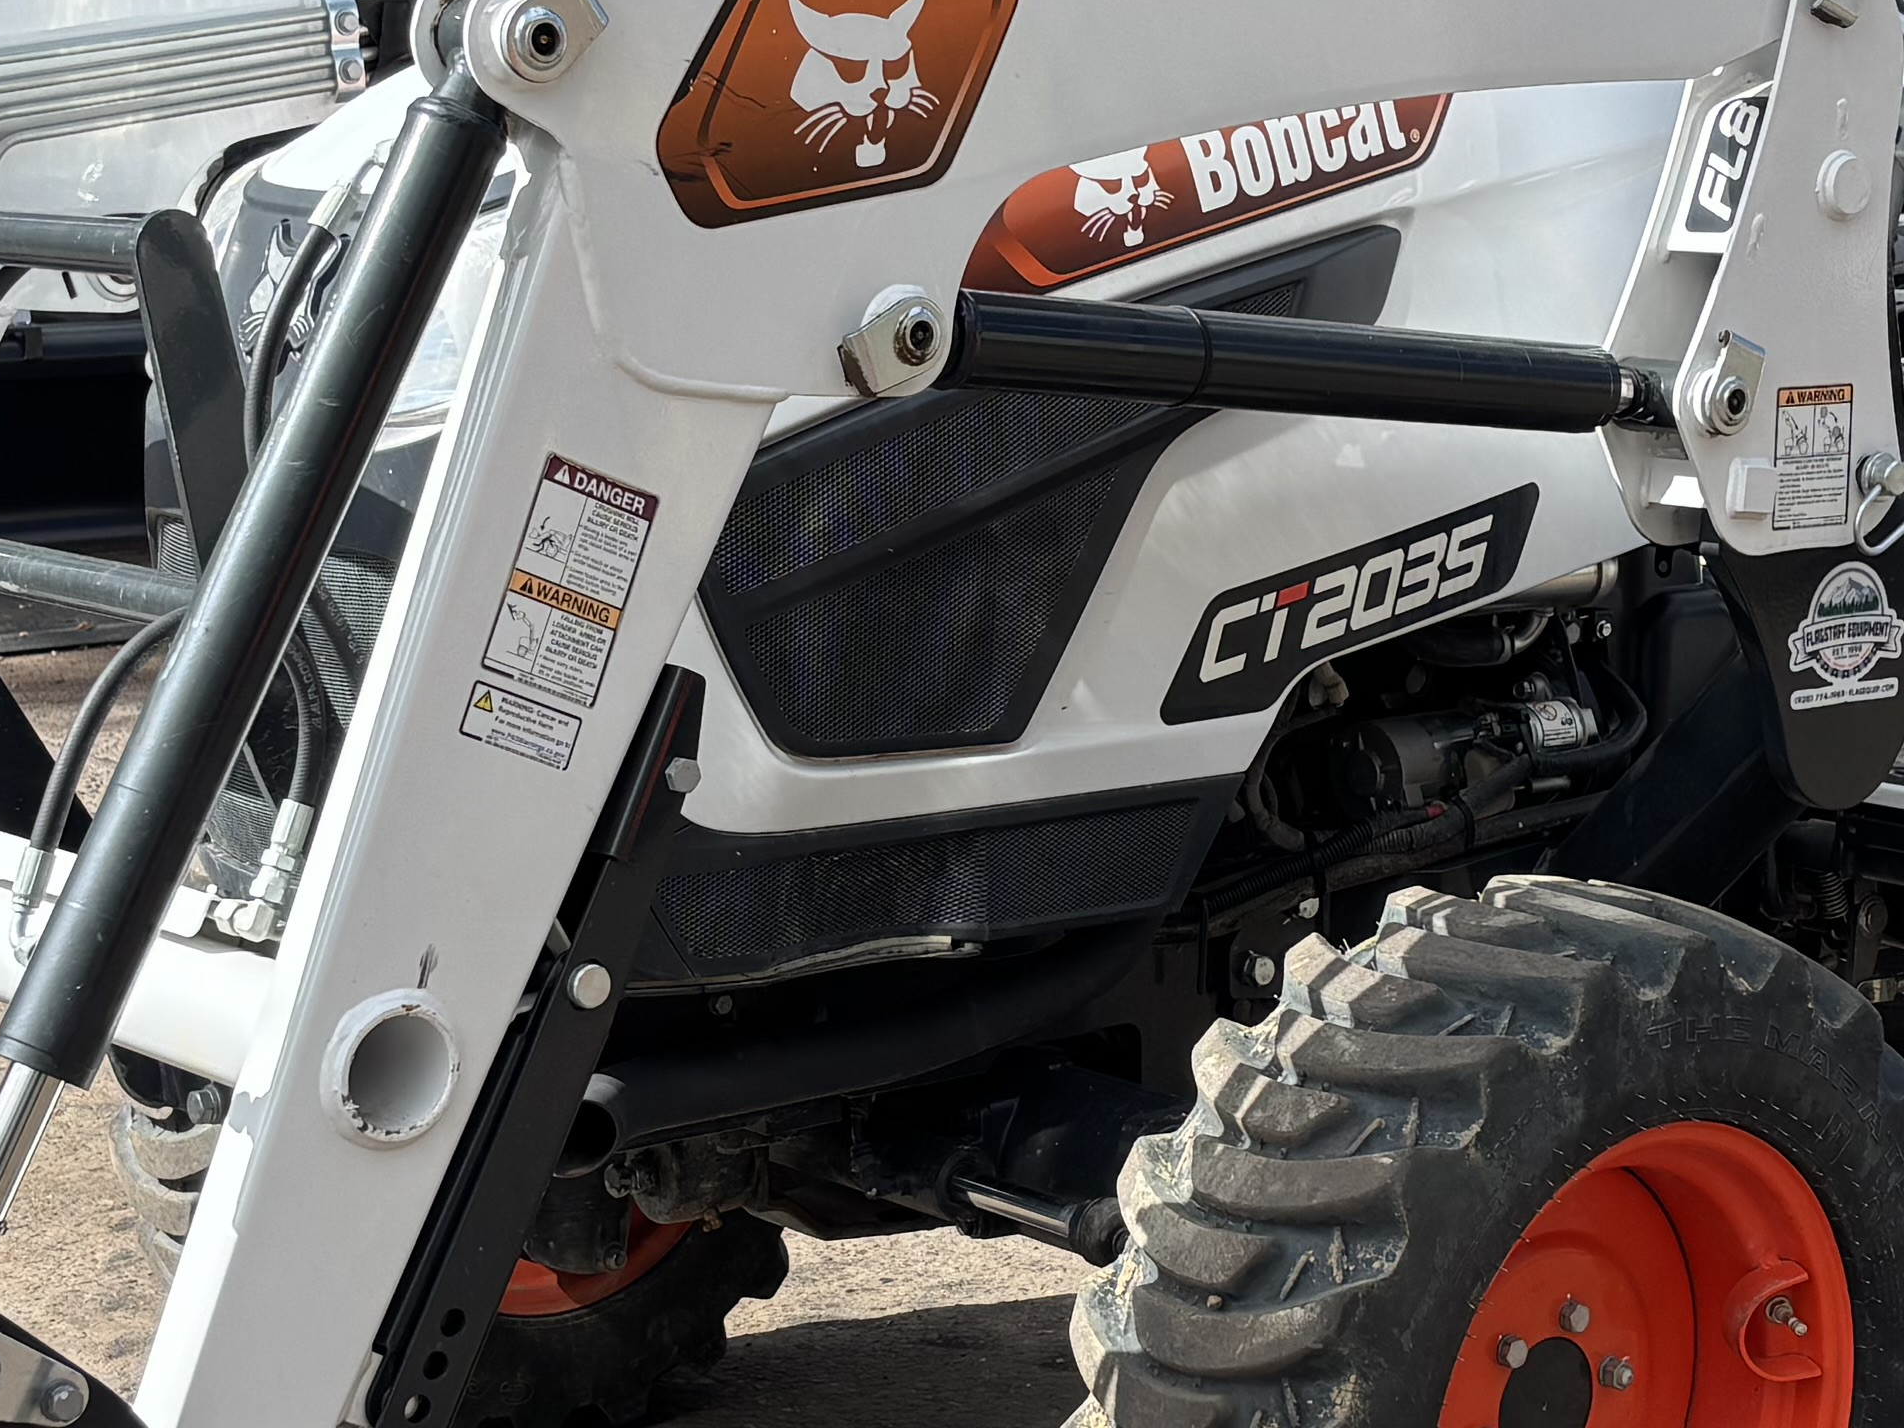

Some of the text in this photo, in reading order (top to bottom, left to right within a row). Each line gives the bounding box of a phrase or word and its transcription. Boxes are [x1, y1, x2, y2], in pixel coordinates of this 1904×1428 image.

[1179, 100, 1407, 213] Bobcat
[1797, 388, 1845, 404] WARNING
[573, 472, 646, 516] DANGER
[537, 581, 610, 623] WARNING
[1199, 514, 1493, 683] CT2035
[1806, 620, 1889, 647] FLAGSTAFF EQUIPMENT
